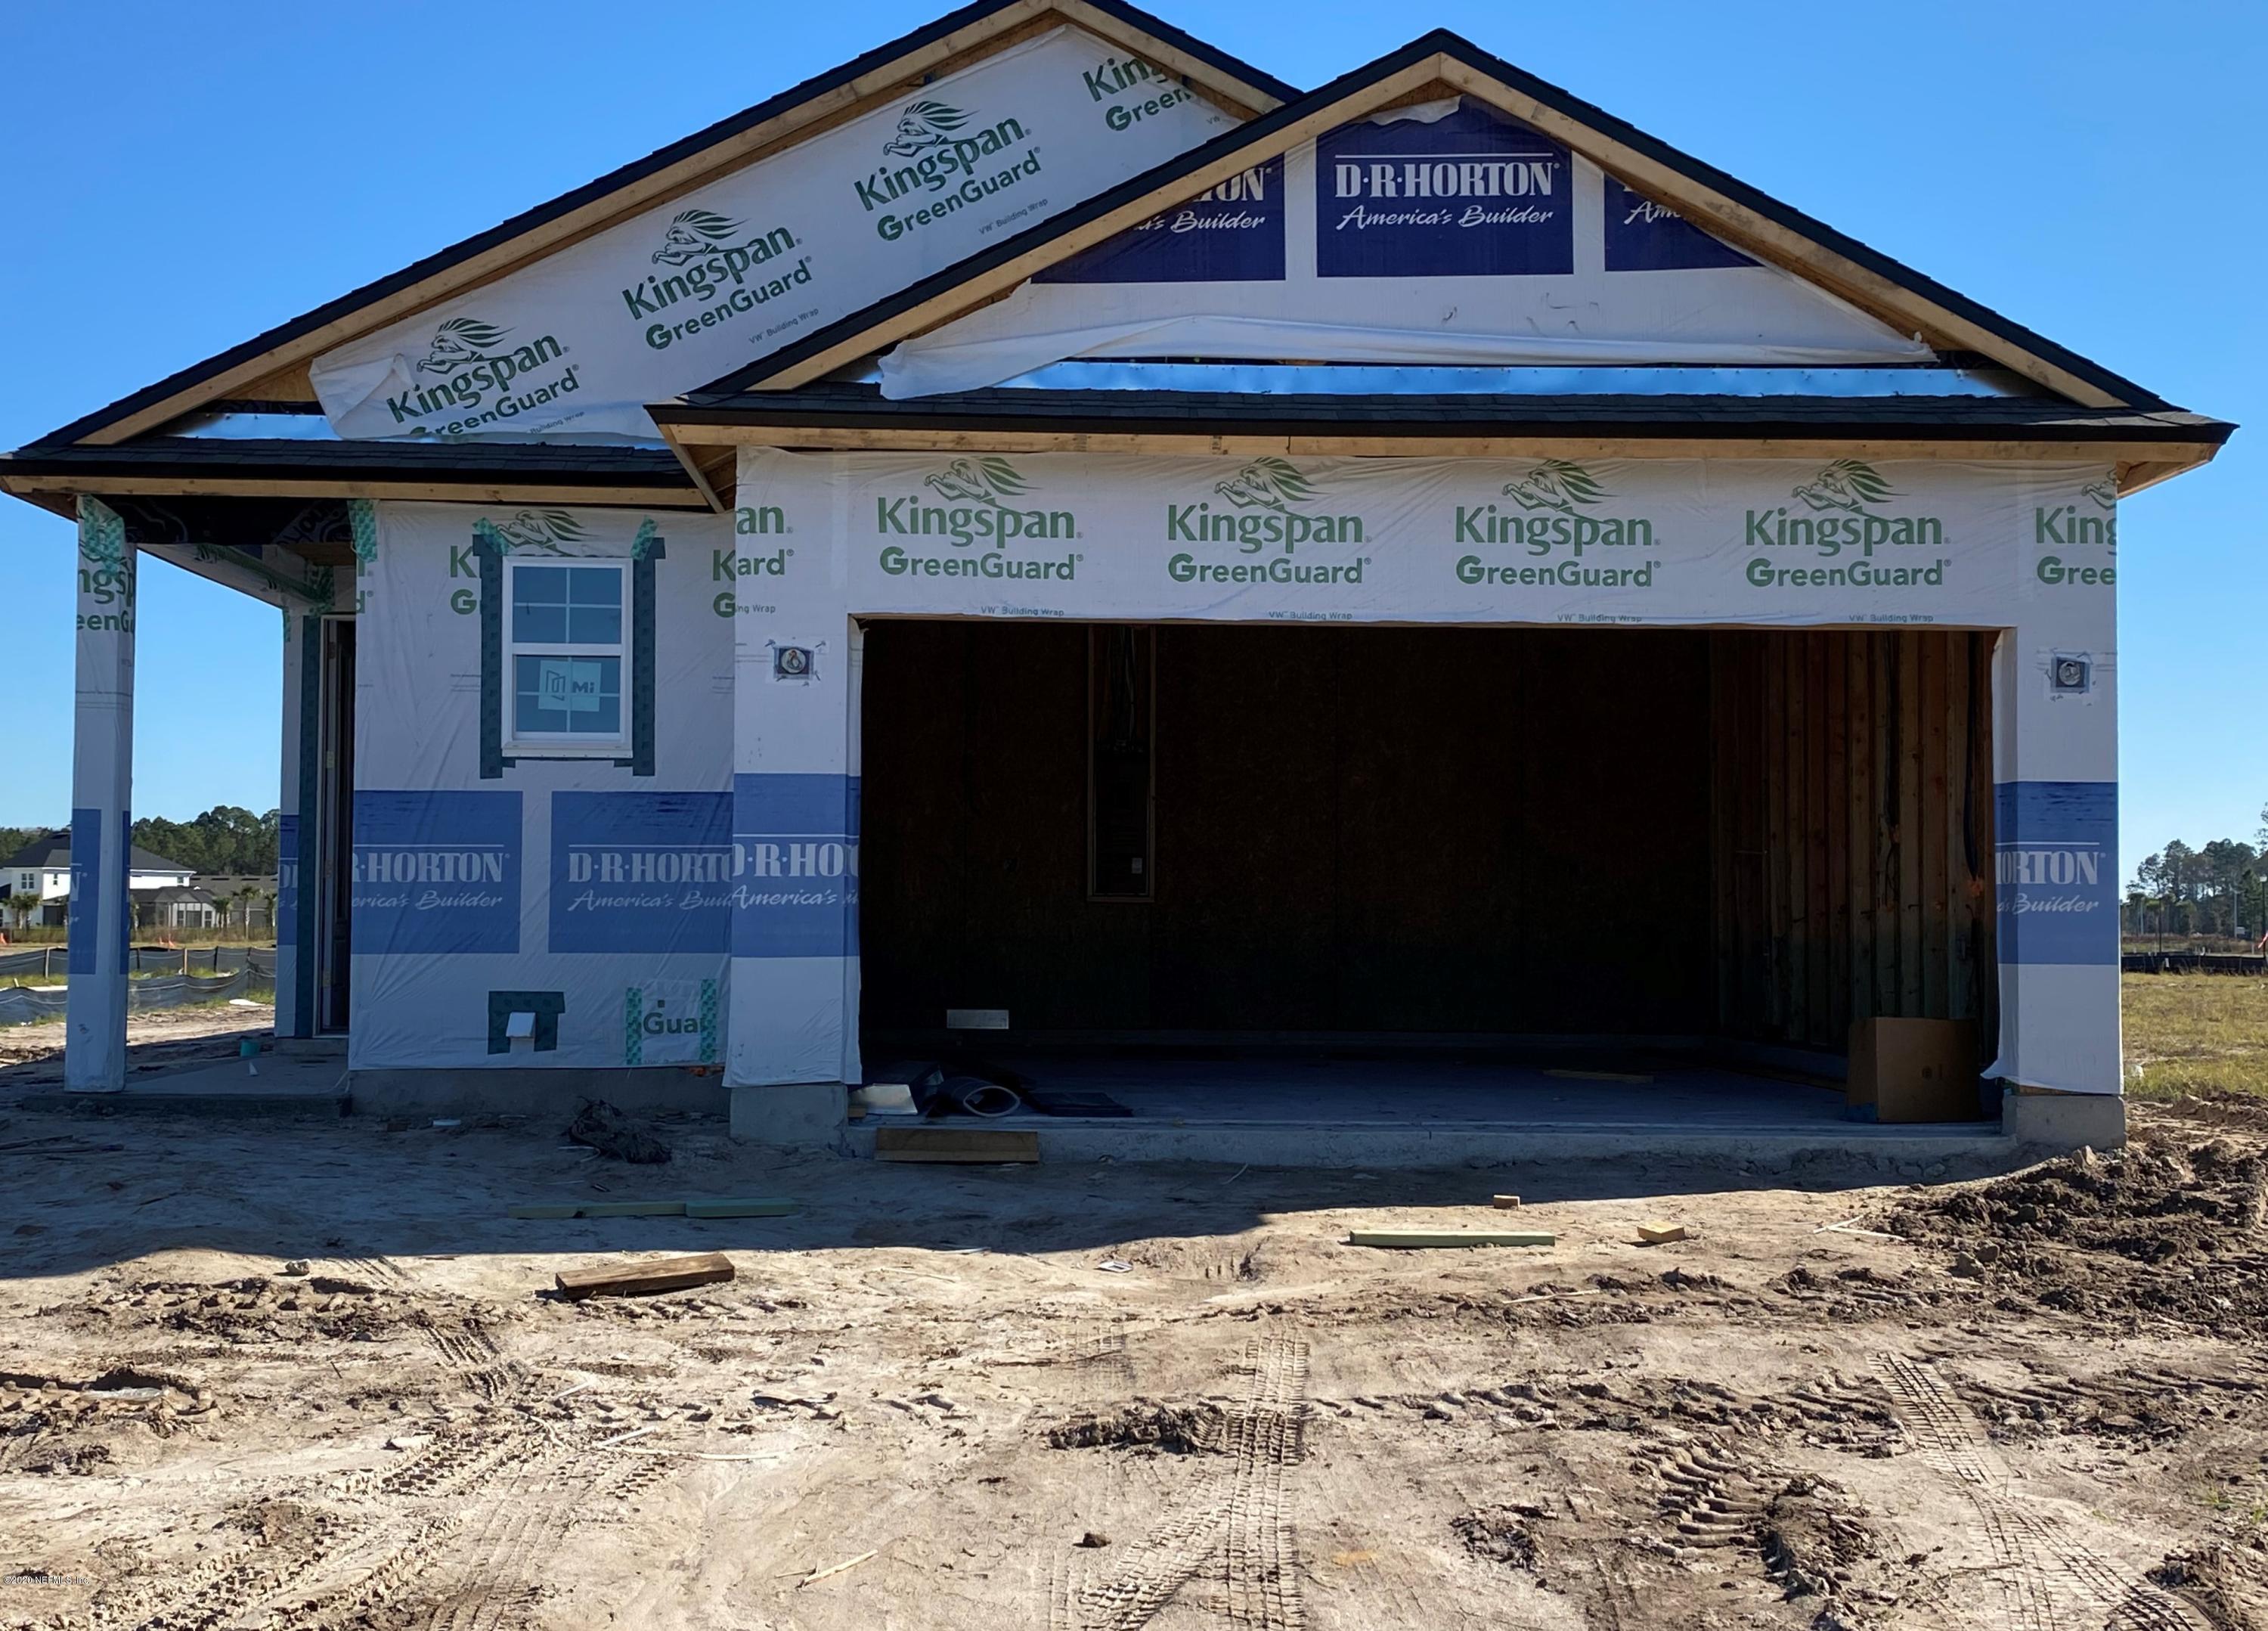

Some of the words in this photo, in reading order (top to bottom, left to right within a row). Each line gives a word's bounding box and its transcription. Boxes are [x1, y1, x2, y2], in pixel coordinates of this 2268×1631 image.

[855, 118, 1024, 211] Kingspan
[878, 150, 1041, 240] GreenGuard
[996, 208, 1028, 228] Building
[1027, 198, 1048, 212] Wrap
[1170, 210, 1266, 234] Builder
[1336, 205, 1452, 230] America's
[1458, 204, 1554, 228] Builder
[621, 226, 795, 321] Kingspan
[646, 259, 812, 349] GreenGuard
[766, 318, 798, 337] Building
[798, 308, 819, 321] Wrap
[386, 335, 562, 423] Kingspan
[563, 411, 584, 423] Wrap
[877, 496, 1075, 548] Kingspan
[1168, 503, 1363, 553] Kingspan
[1456, 504, 1652, 556] Kingspan
[1746, 507, 1942, 557] Kingspan
[879, 547, 1075, 580] GreenGuard
[1168, 553, 1362, 584] GreenGuard
[1456, 556, 1652, 587] GreenGuard
[1746, 558, 1942, 587] GreenGuard
[752, 605, 776, 613] Wrap
[1002, 606, 1039, 616] Building
[1041, 608, 1064, 617] Wrap
[1290, 611, 1326, 620] Building
[1579, 613, 1616, 623] Building
[1870, 614, 1907, 623] Building
[1909, 614, 1934, 622] Wrap
[416, 890, 503, 910] Builder
[567, 888, 675, 911] America's
[732, 885, 837, 910] America's
[2012, 892, 2099, 915] Builder
